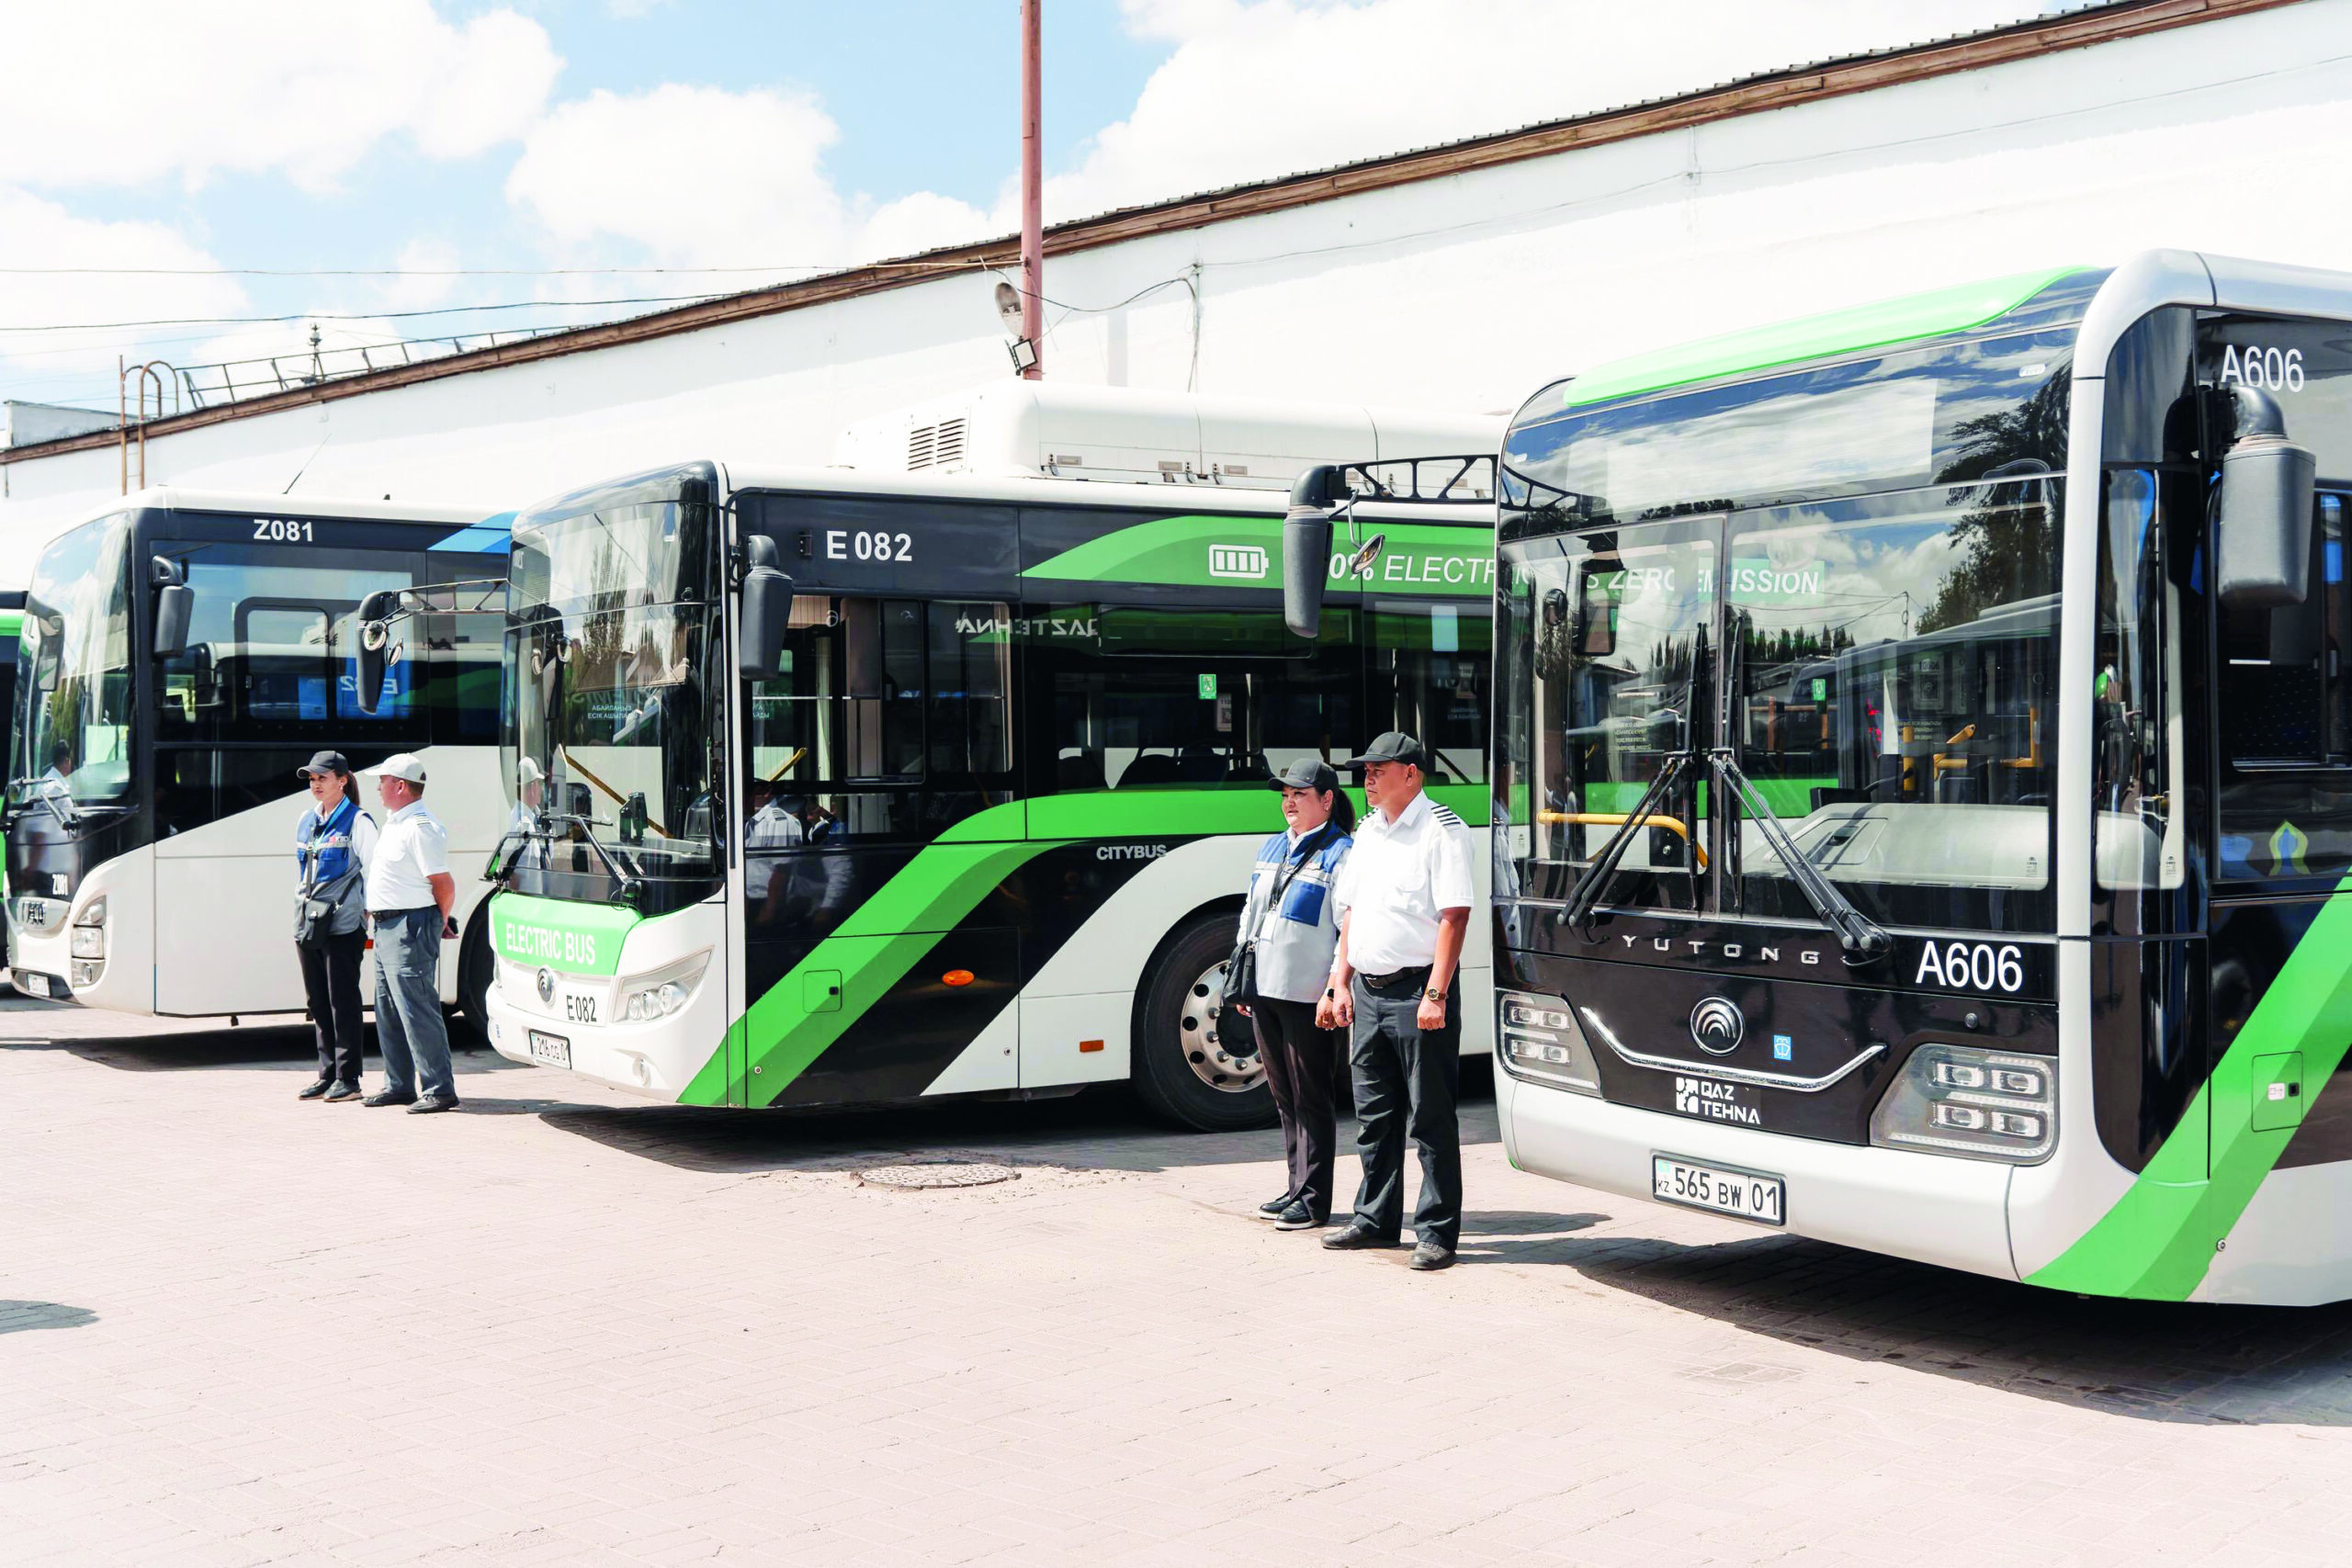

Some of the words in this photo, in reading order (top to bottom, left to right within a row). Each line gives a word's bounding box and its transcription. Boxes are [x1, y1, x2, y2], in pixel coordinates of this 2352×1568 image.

[2221, 344, 2304, 392] A606
[254, 519, 312, 542] Z081
[1096, 844, 1167, 861] CITYBUS
[507, 922, 561, 960] ELECTRIC
[565, 931, 595, 965] BUS
[1622, 934, 1821, 964] YUTONG
[1915, 941, 2023, 992] A606
[1701, 1082, 1735, 1101] QAZ
[1701, 1100, 1761, 1125] TEHNA
[1657, 1180, 1670, 1193] KZ
[1675, 1167, 1711, 1201] 565
[1718, 1182, 1742, 1208] BW
[1751, 1182, 1778, 1215] 01
